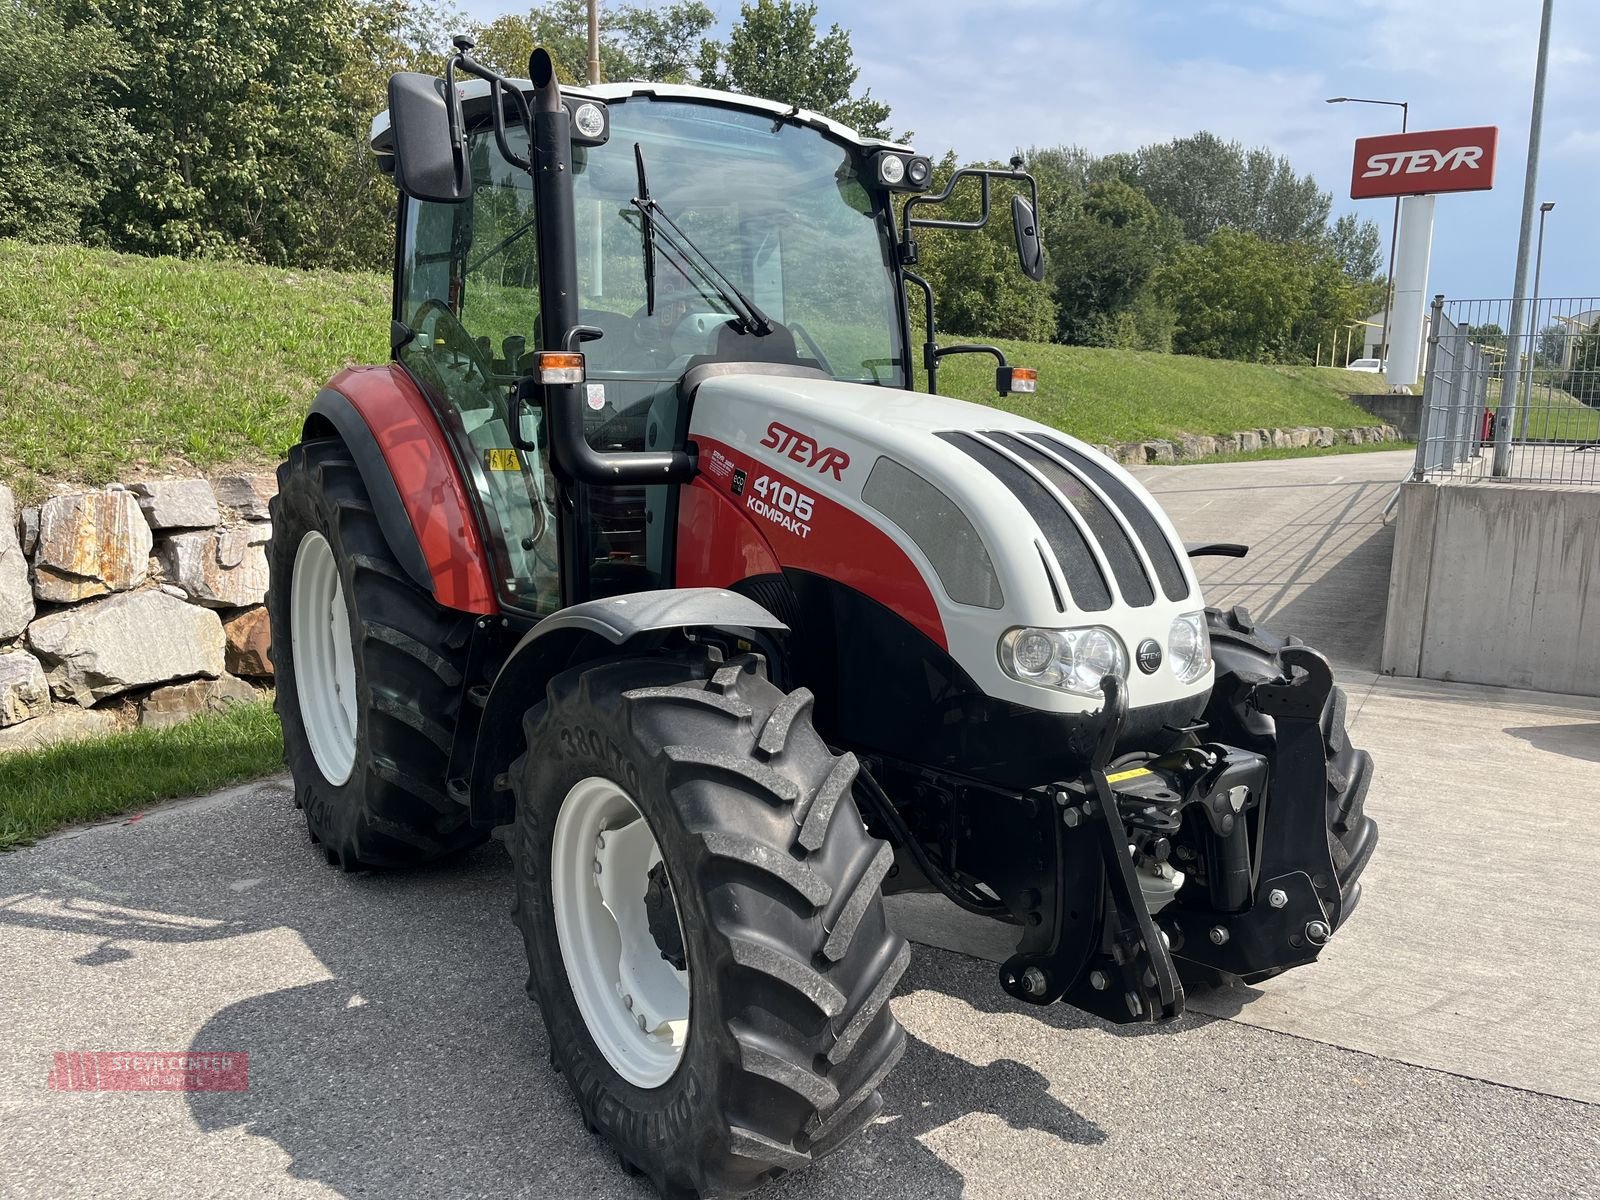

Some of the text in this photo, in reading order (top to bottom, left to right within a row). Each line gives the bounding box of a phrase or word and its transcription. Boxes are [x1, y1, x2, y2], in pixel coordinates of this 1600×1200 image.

[1361, 146, 1483, 178] STEYR
[760, 421, 850, 482] STEYR
[746, 495, 811, 539] KOMPAKT
[753, 475, 815, 521] 4105
